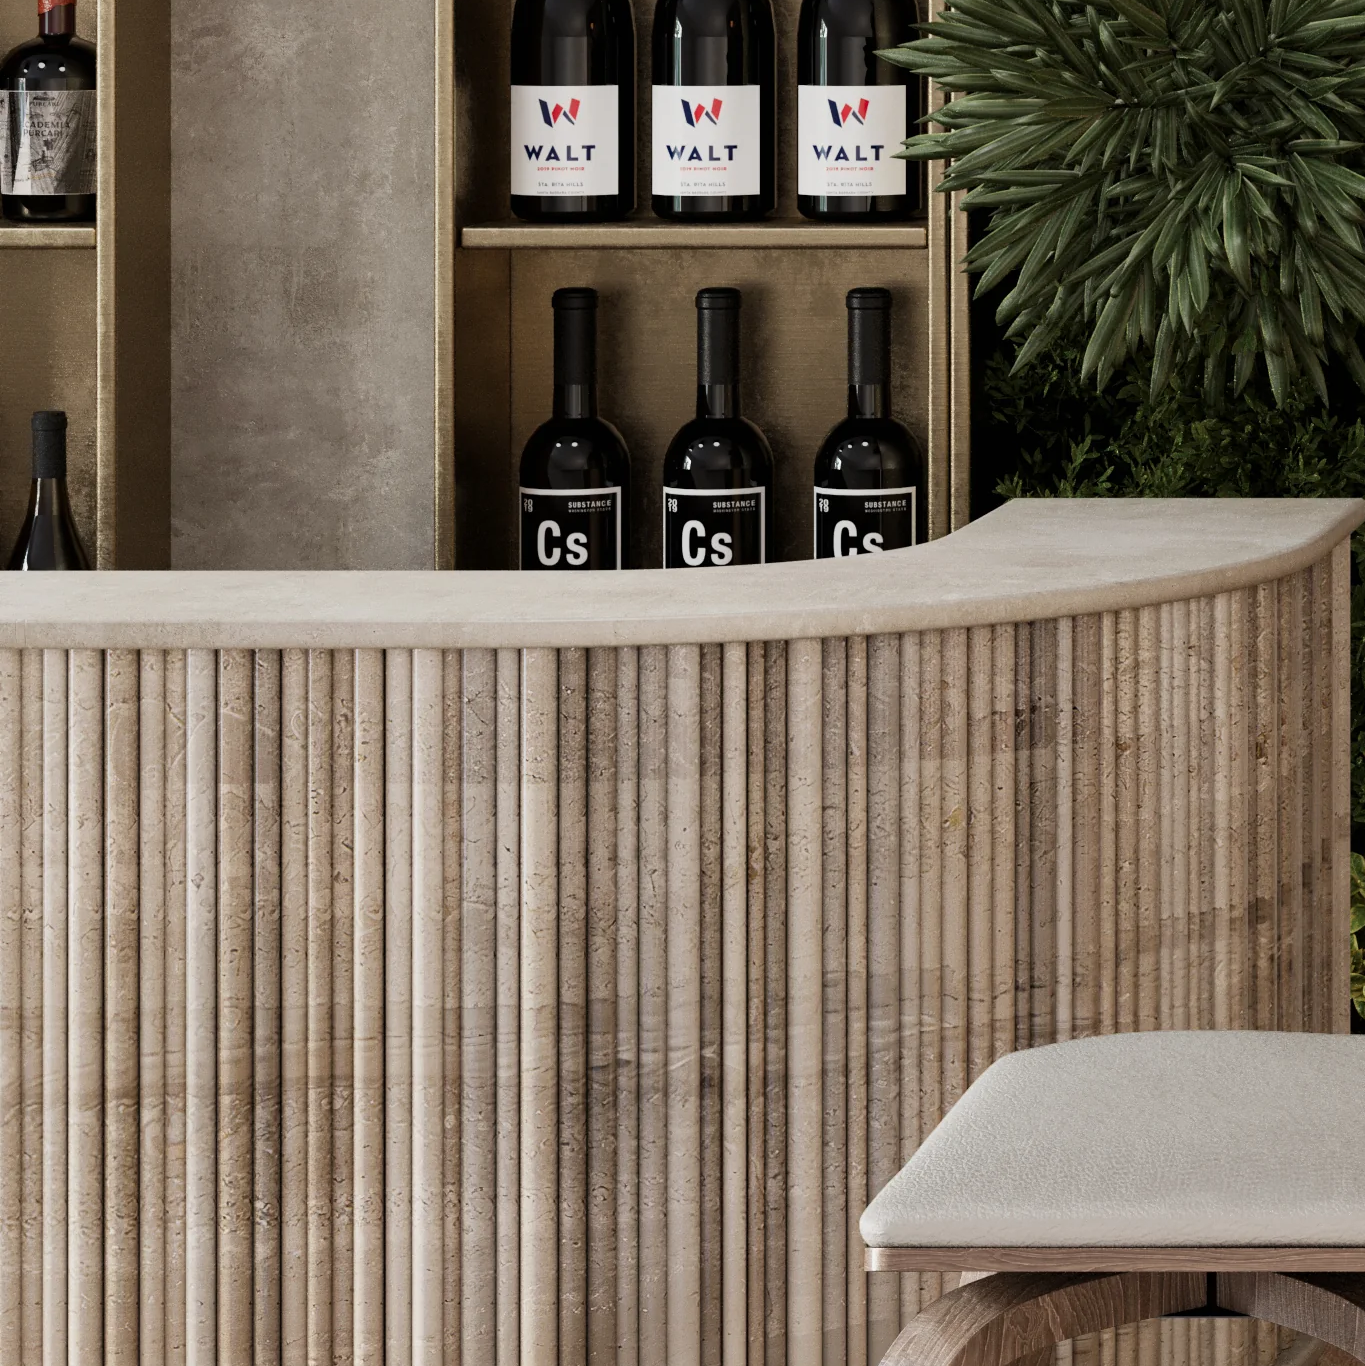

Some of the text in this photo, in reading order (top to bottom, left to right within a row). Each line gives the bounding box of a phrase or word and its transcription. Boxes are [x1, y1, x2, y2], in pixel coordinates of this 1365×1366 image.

[524, 145, 596, 161] WALT
[666, 145, 738, 161] WALT
[812, 145, 884, 161] WALT
[568, 499, 612, 508] SUBSTANCE
[712, 499, 756, 508] SUBSTANCE
[864, 499, 906, 508] SUBSTANCE
[537, 519, 588, 566] Cs
[682, 519, 733, 566] Cs
[833, 519, 884, 557] Cs
